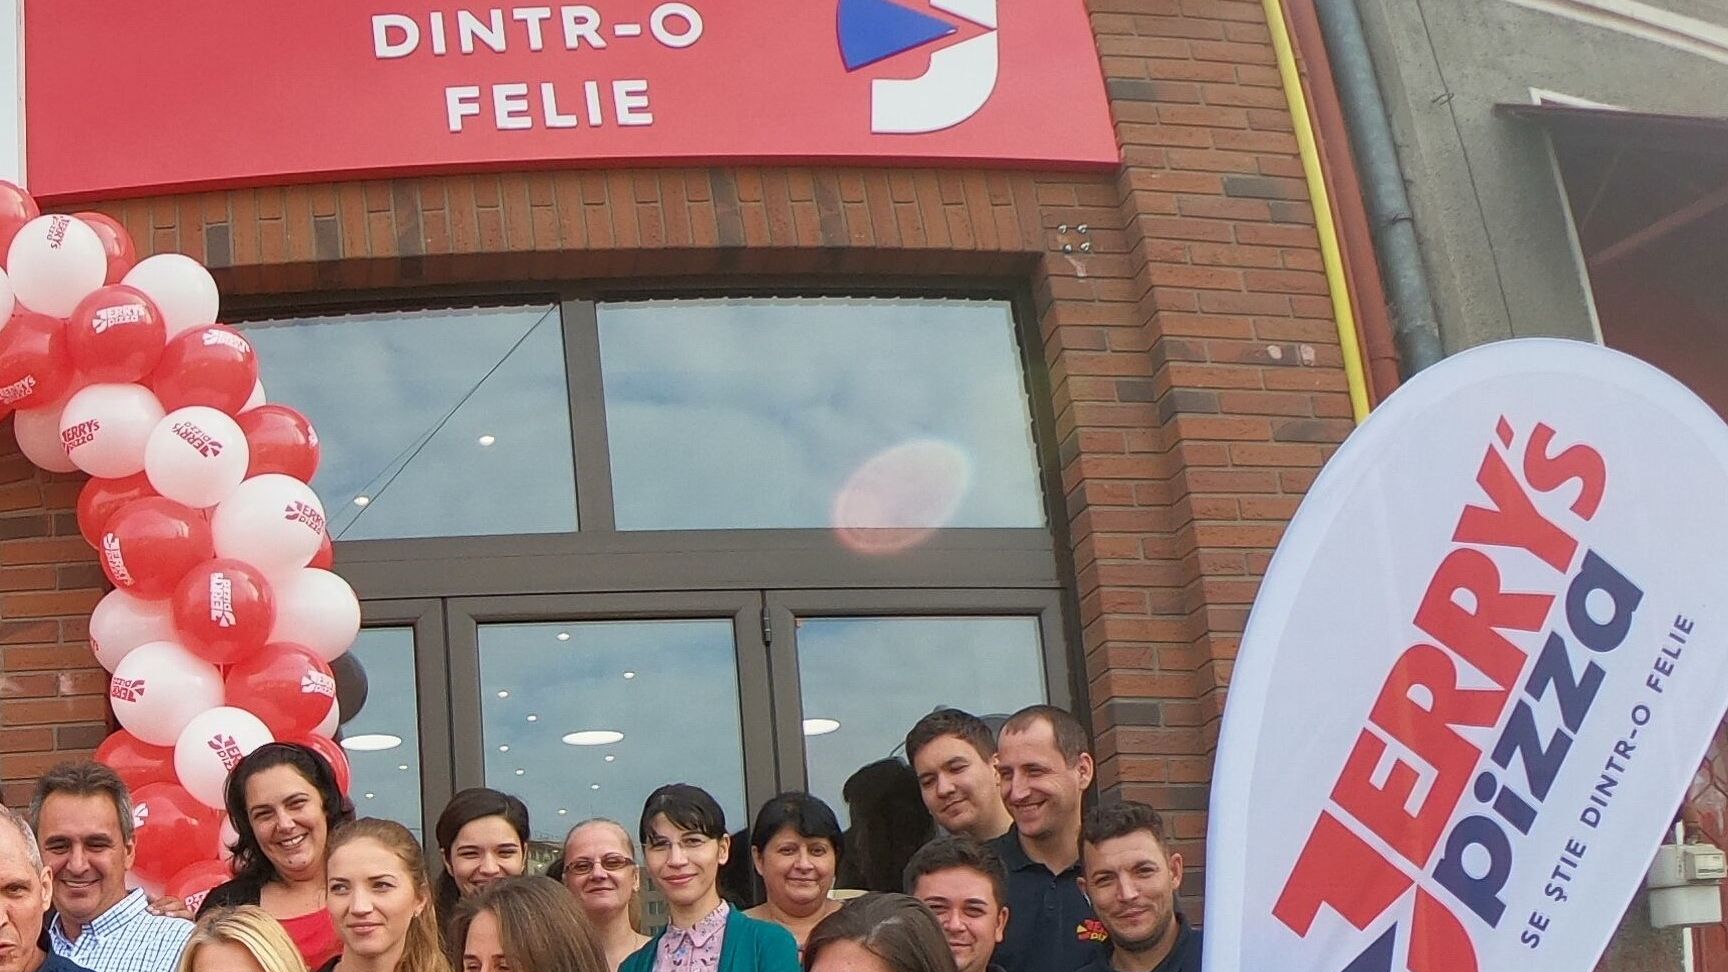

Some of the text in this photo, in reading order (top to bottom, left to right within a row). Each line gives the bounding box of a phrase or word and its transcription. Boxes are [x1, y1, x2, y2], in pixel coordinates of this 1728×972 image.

[373, 2, 704, 58] DINTR-O
[446, 79, 654, 132] FELIE
[1432, 548, 1644, 929] pizza
[1520, 911, 1550, 949] SE
[1582, 703, 1652, 829] DINTR-O
[1647, 613, 1695, 695] FELIE
